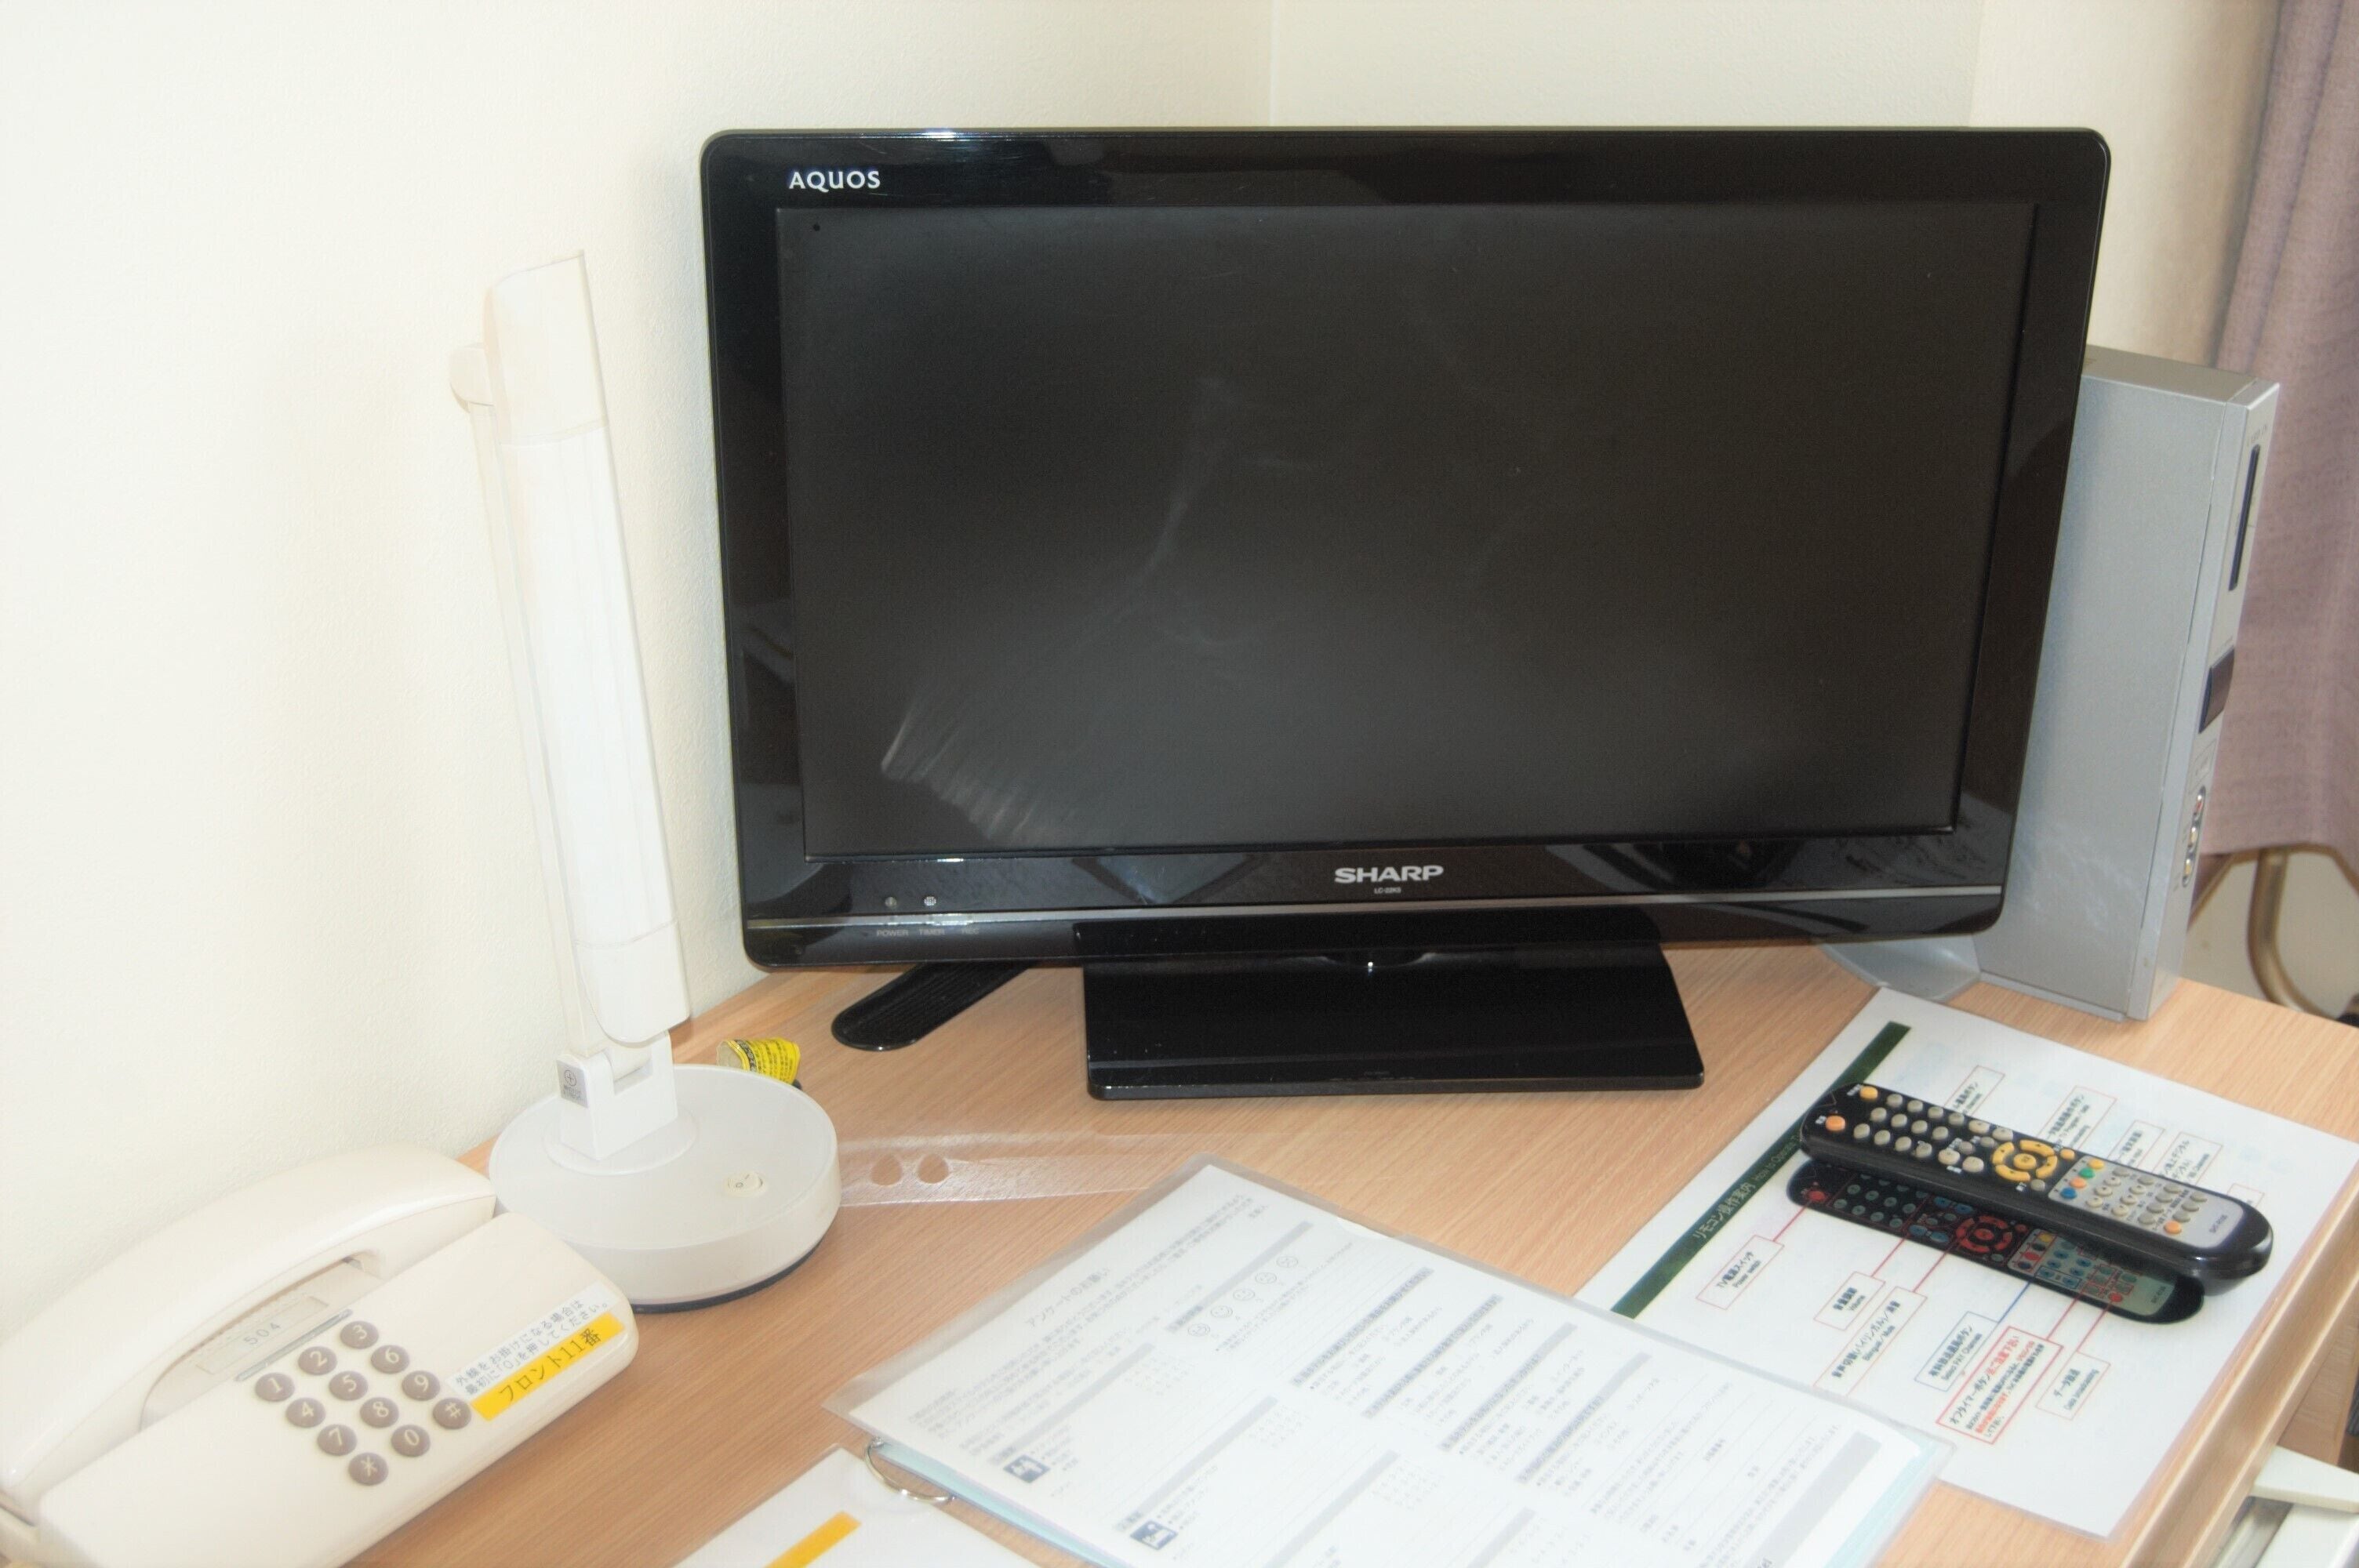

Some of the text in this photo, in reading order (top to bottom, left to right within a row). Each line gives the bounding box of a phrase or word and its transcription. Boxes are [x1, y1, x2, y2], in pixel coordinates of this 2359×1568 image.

[788, 169, 881, 193] AQUOS
[1334, 865, 1444, 884] SHARP
[1750, 1170, 1770, 1181] How
[1692, 1181, 1756, 1239] リモコン操作案内
[1715, 1250, 1754, 1288] TV電源スイッチ
[1732, 1273, 1750, 1288] Power
[1848, 1294, 1866, 1312] Volume
[244, 1322, 281, 1345] 504
[354, 1324, 367, 1340] 3
[456, 1299, 585, 1387] 外線をお掛けになる場合は
[310, 1350, 328, 1367] 2
[385, 1346, 400, 1363] 6
[500, 1327, 602, 1403] フロント11番
[270, 1377, 283, 1394] 1
[343, 1374, 357, 1392] 5
[414, 1374, 429, 1392] 9
[301, 1401, 314, 1418] 4
[373, 1401, 389, 1418] 8
[329, 1427, 343, 1447] 7
[403, 1428, 420, 1446] 0
